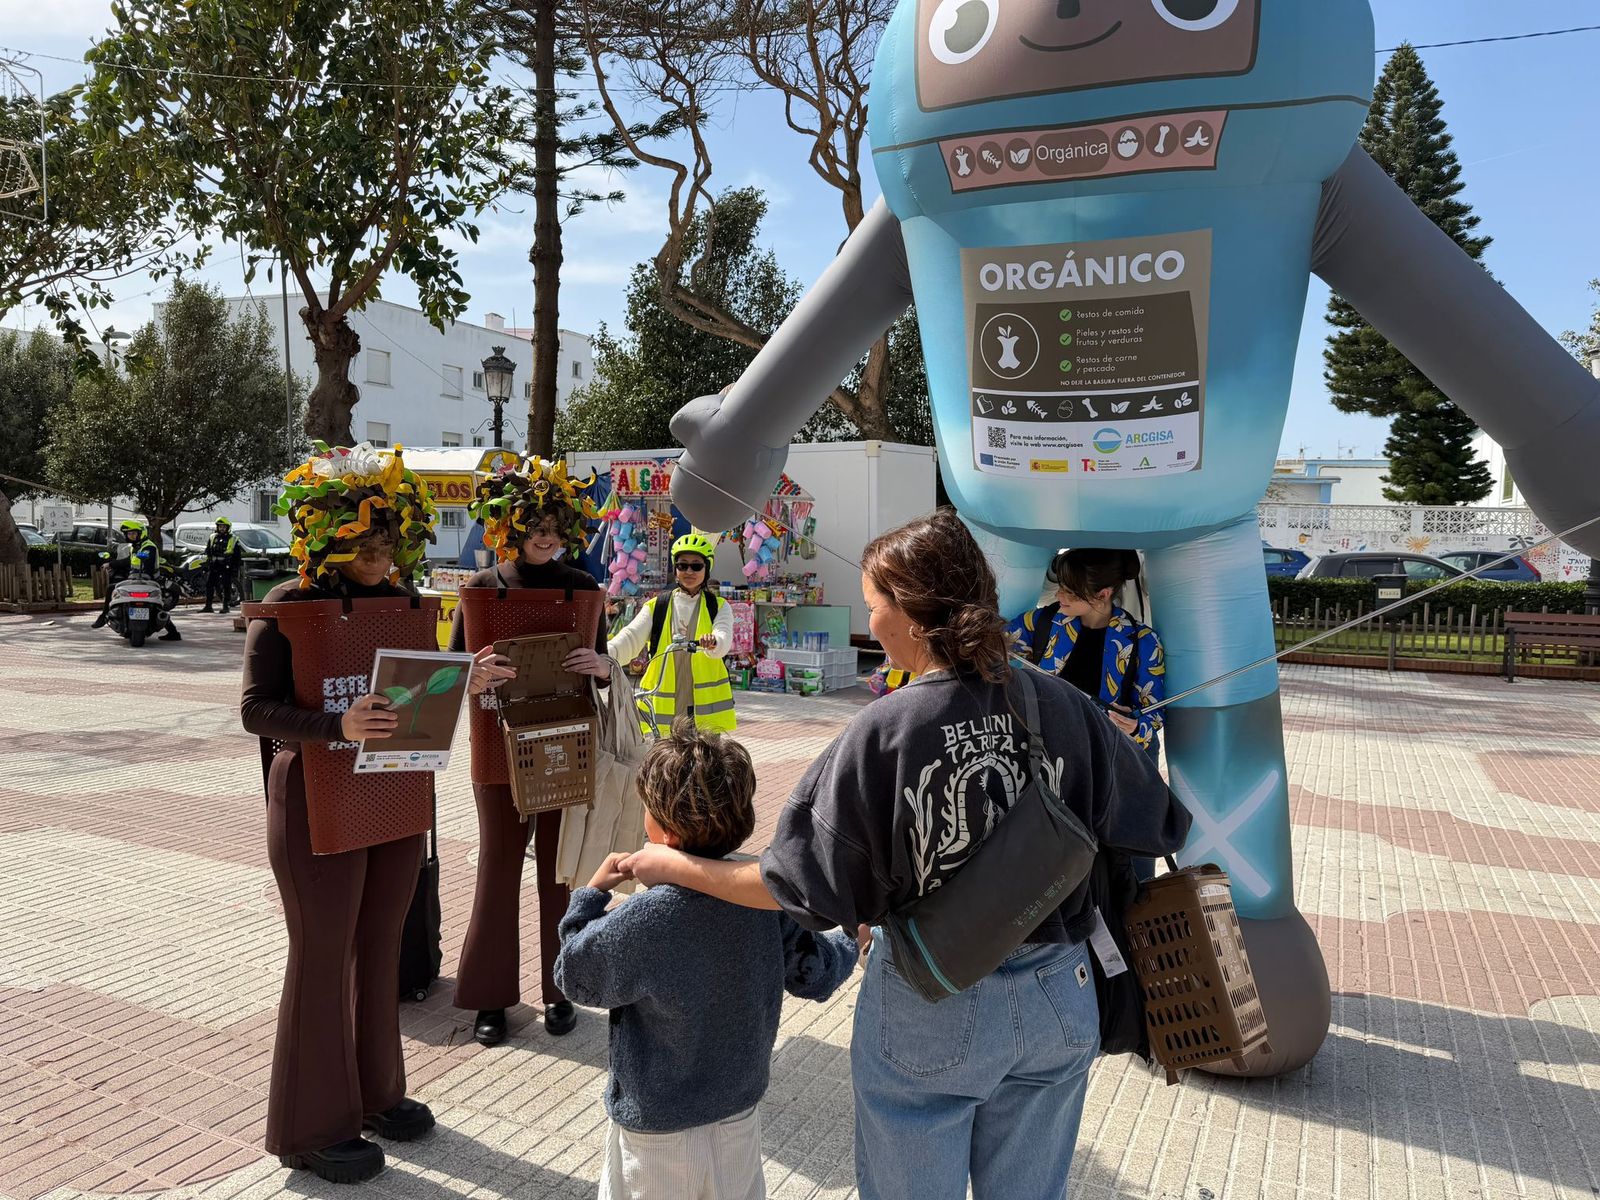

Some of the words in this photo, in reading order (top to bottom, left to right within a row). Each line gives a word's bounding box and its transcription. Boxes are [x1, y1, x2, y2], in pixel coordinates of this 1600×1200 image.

[1036, 141, 1109, 163] Orgánica
[979, 250, 1185, 292] ORGÁNICO
[1076, 310, 1100, 318] Restos
[1102, 308, 1112, 318] de
[1115, 307, 1144, 317] comida
[1076, 328, 1099, 337] Pieles
[1108, 327, 1131, 336] restos
[1134, 325, 1144, 333] de
[1076, 338, 1098, 346] frutas
[1108, 336, 1143, 345] verduras
[1076, 356, 1100, 364] Restos
[1102, 354, 1112, 363] de
[1083, 364, 1115, 374] pescado
[1148, 371, 1186, 381] CONTENEDOR
[1125, 430, 1174, 445] ARCGISA
[323, 674, 368, 697] ESTE
[940, 713, 1014, 748] BELLINI
[945, 733, 1018, 764] TARIFA
